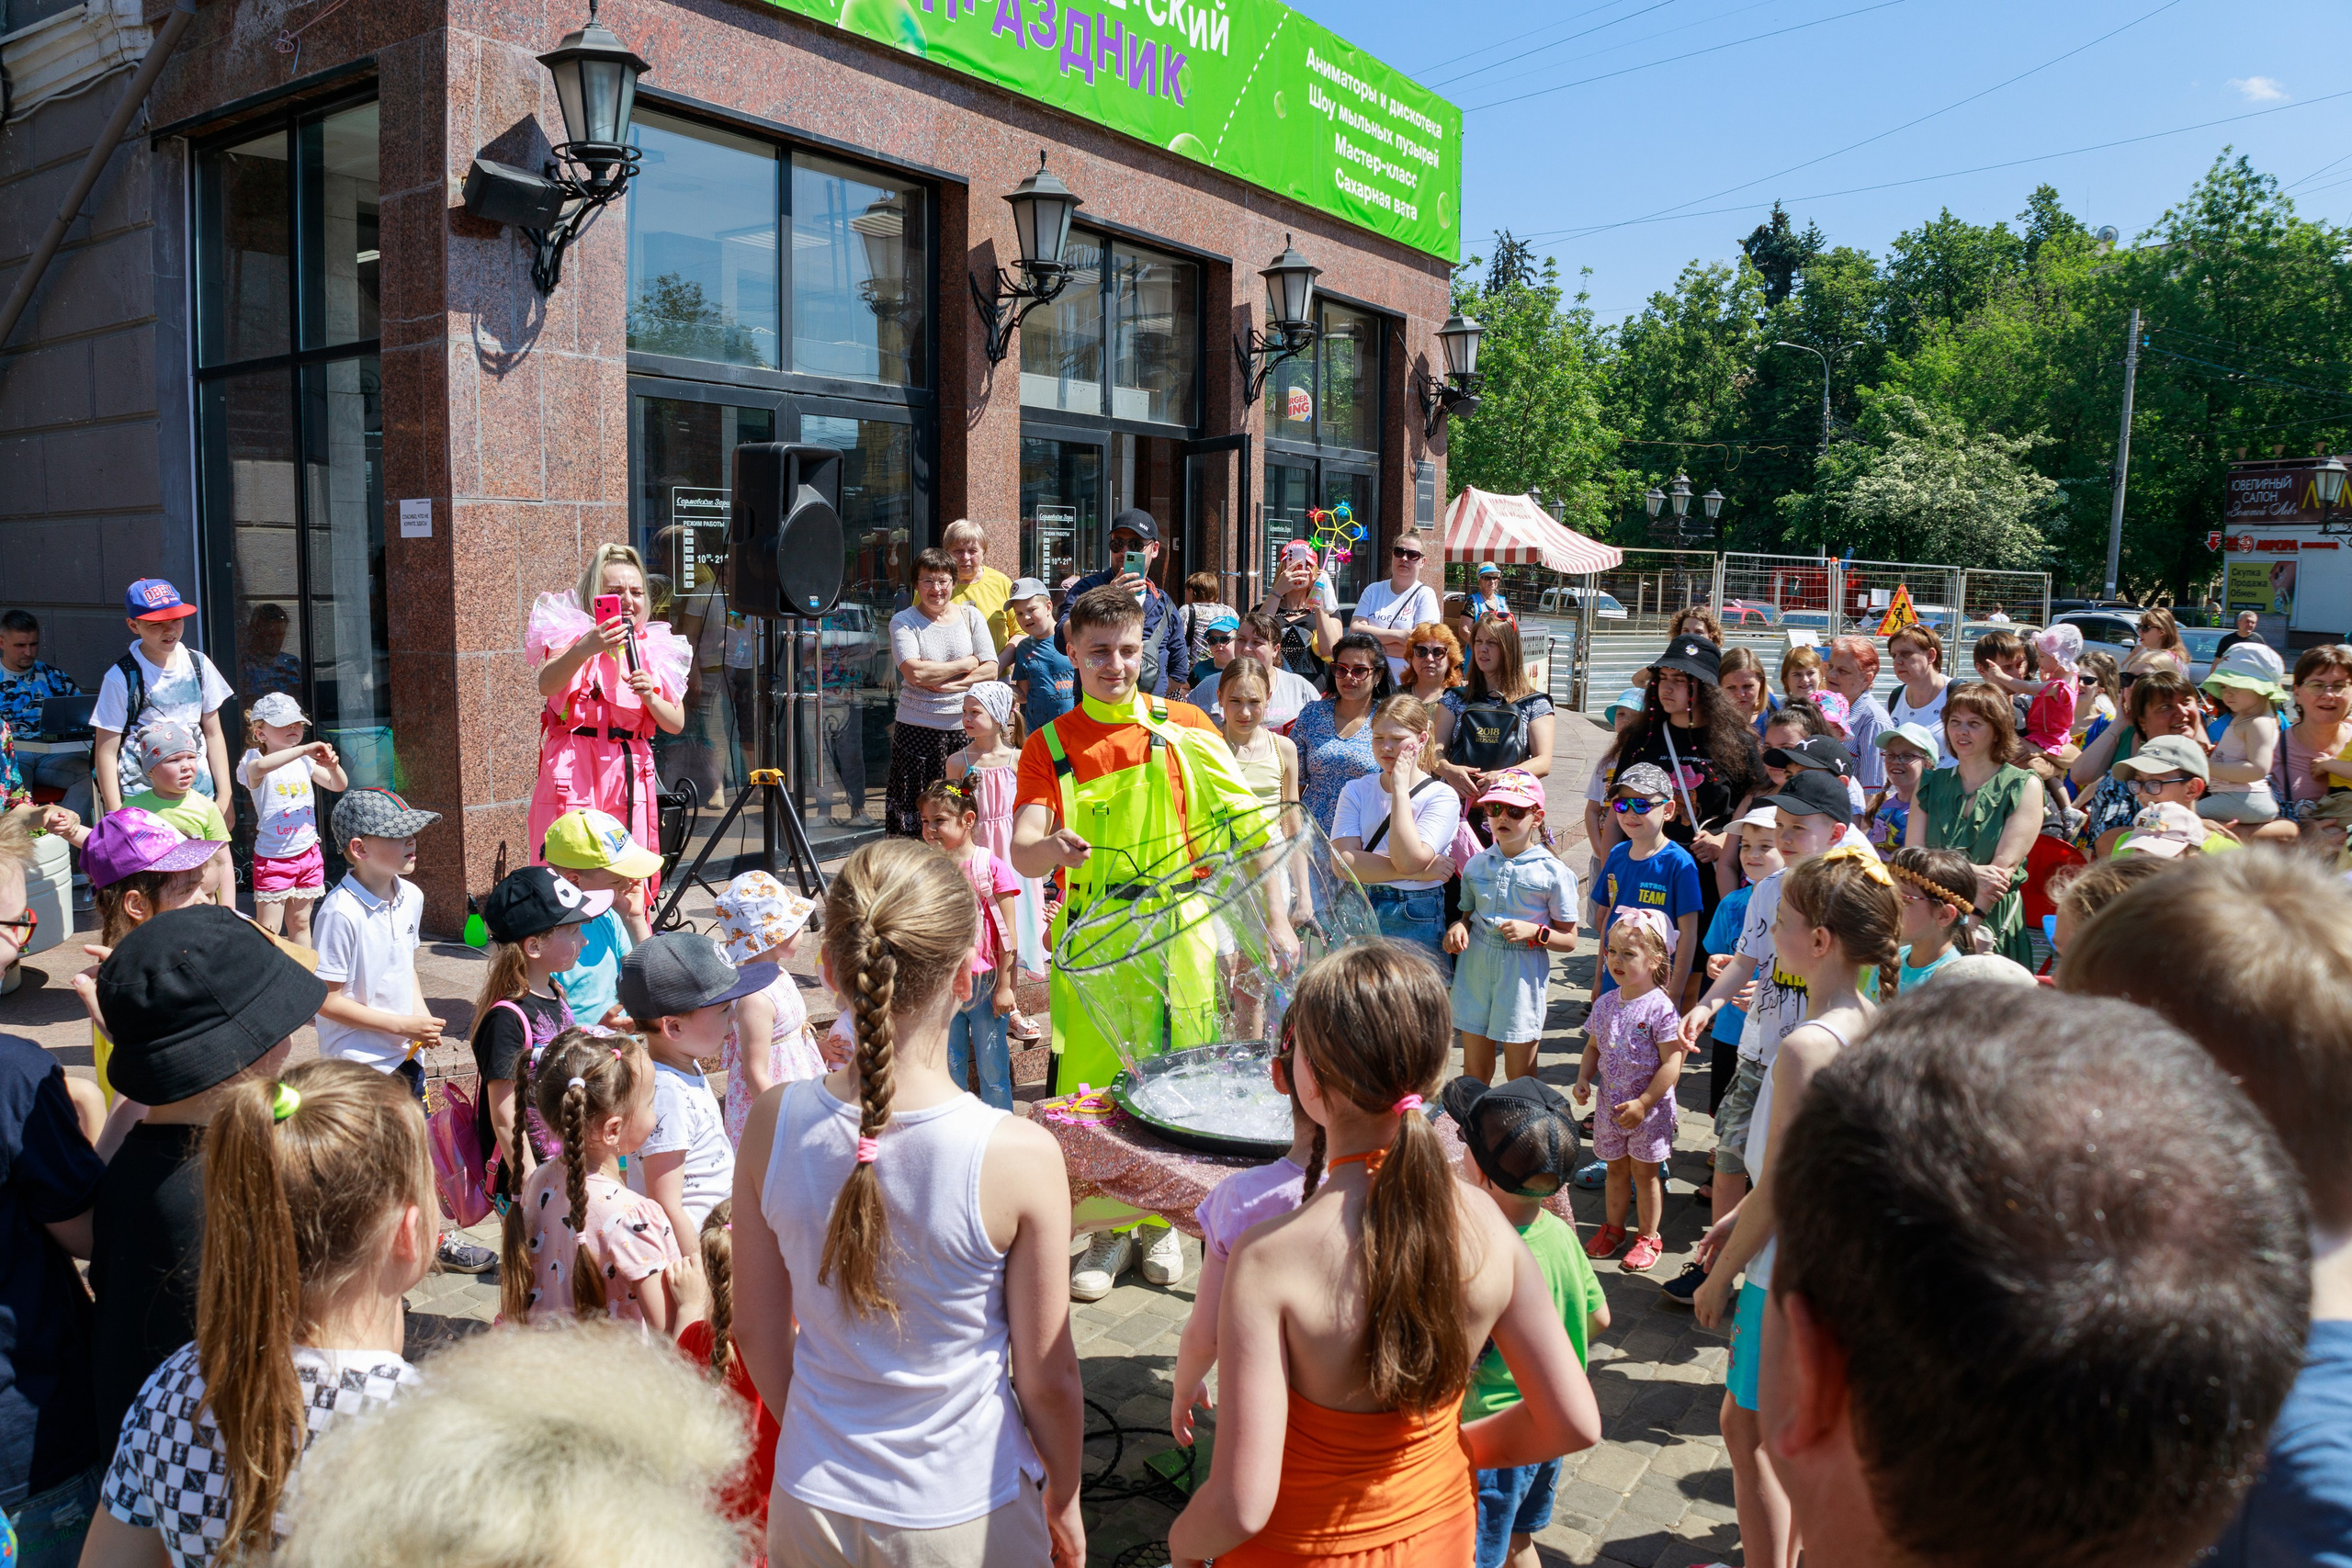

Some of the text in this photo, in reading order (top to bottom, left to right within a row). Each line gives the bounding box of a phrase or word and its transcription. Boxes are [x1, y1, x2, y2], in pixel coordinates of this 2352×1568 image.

[920, 0, 1188, 108] АЗДНИК
[1306, 47, 1442, 140] Аниматоры и дискотека
[1308, 83, 1440, 169] Шоу мыльных пузырей
[1335, 132, 1418, 189] Мастер-класс
[1335, 167, 1418, 221] Сахарная вата
[1288, 394, 1308, 405] RGER
[1288, 401, 1309, 417] ING
[2231, 474, 2292, 491] ЮВЕЛИРНЫЙ
[2242, 491, 2278, 503] САЛОН
[2231, 568, 2261, 578] Скупка
[2231, 579, 2267, 589] Продажа
[144, 584, 175, 603] OBEY
[2230, 589, 2257, 597] Обмен
[1476, 727, 1500, 736] 2018
[277, 823, 299, 835] Let's
[1639, 882, 1668, 892] PATROL
[1638, 888, 1667, 906] TEAM
